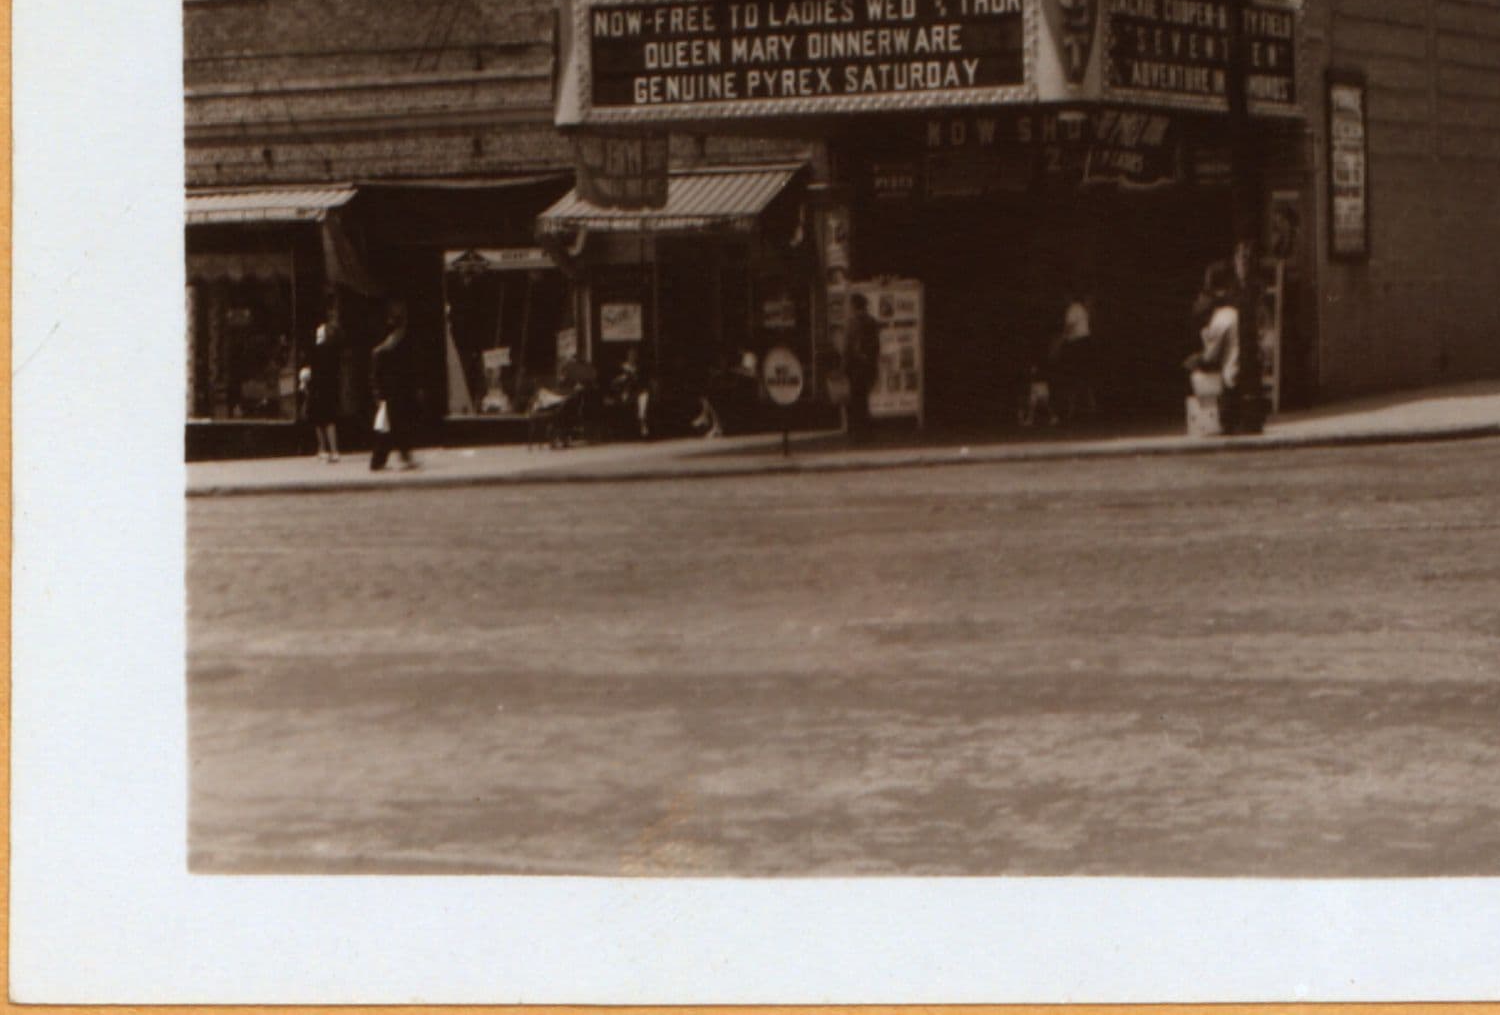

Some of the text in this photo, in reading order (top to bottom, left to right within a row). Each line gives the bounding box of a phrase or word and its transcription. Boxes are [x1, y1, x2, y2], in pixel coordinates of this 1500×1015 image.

[594, 5, 716, 37] NOW-FREE
[730, 3, 758, 30] TO
[645, 24, 962, 69] QUEEN MARY DINNERWARE
[633, 58, 979, 104] GENUINE PYREX SATURDAY
